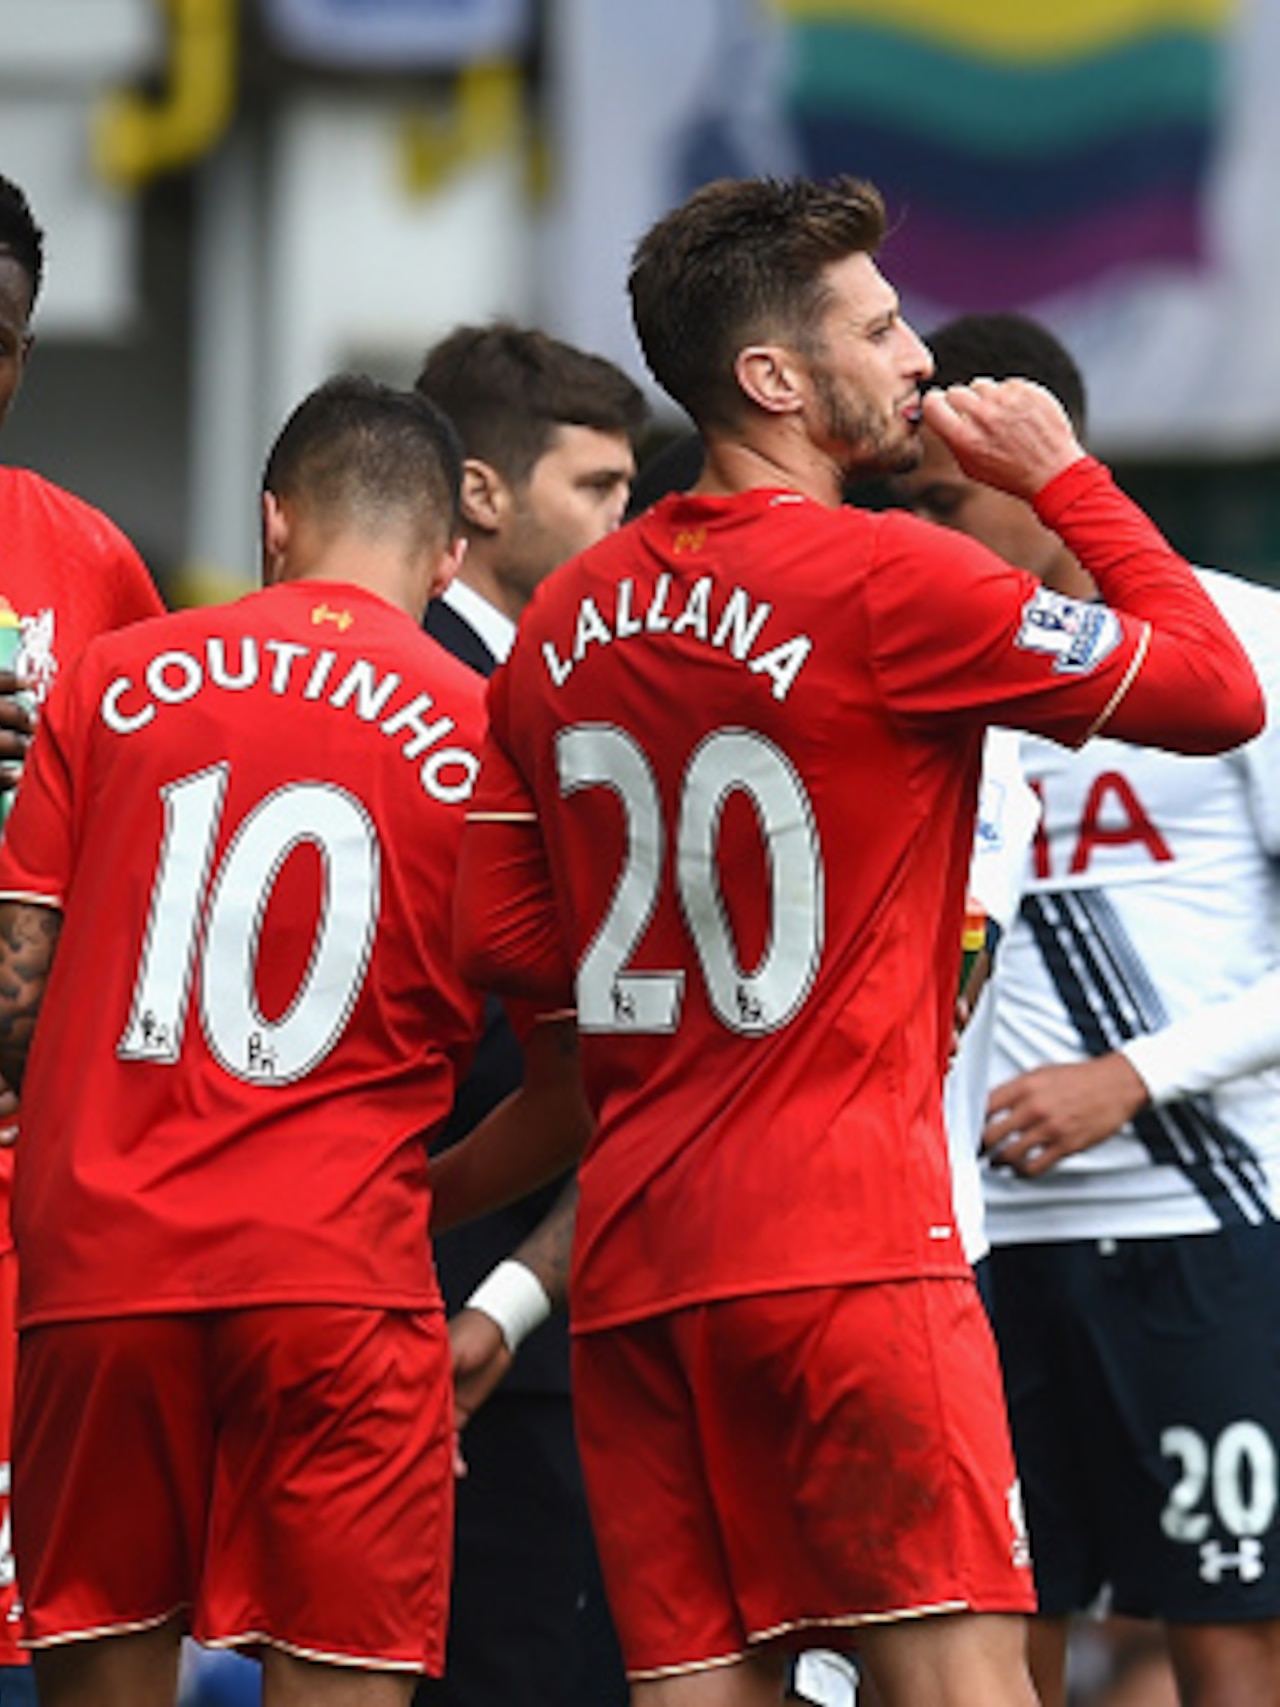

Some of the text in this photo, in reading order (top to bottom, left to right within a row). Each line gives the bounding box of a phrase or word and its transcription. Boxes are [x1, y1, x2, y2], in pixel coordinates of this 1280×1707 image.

[100, 635, 481, 804] COUTINHO
[542, 572, 813, 701] LALLANA
[116, 758, 382, 1088] 10
[554, 720, 826, 1038] 20
[1159, 1420, 1278, 1544] 20
